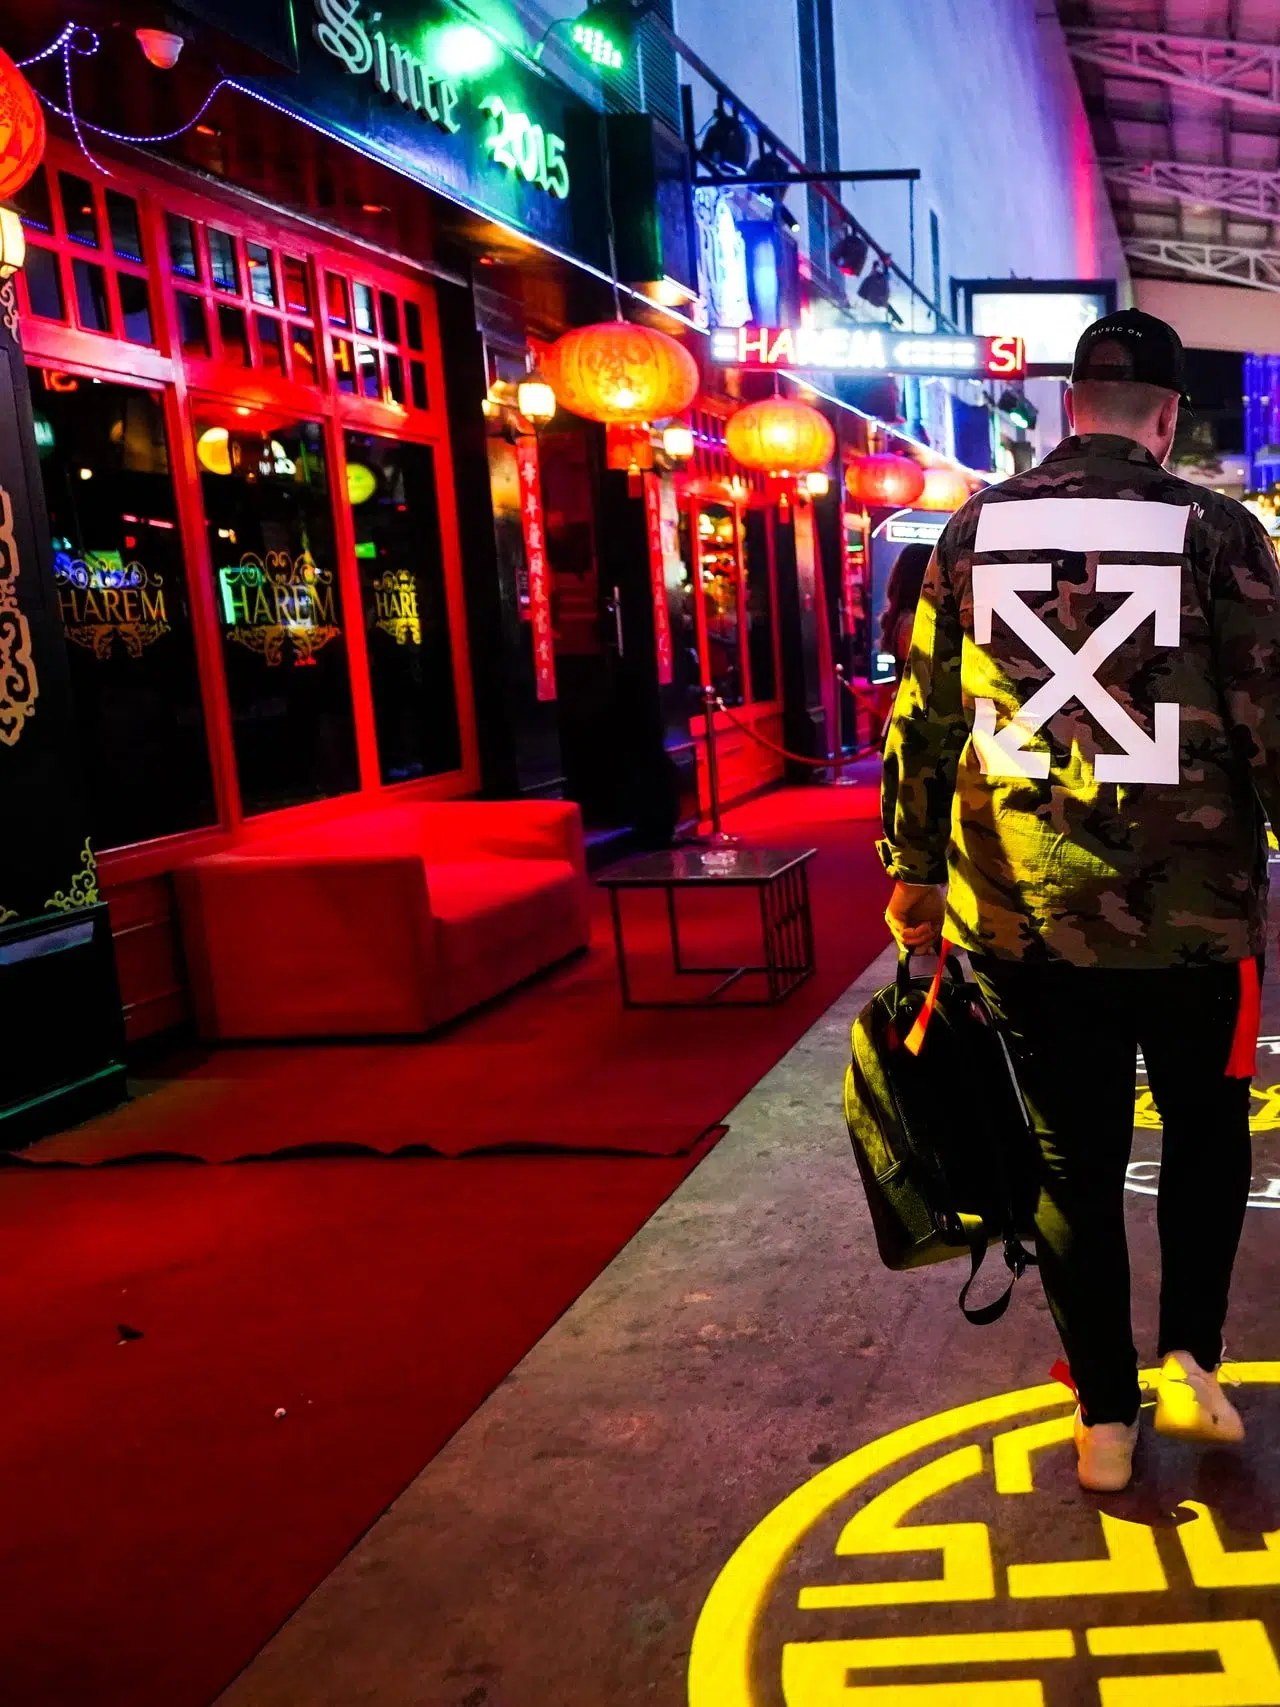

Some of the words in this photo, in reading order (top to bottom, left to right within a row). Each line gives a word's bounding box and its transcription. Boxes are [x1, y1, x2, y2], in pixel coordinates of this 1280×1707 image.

[313, 0, 460, 134] Since
[478, 95, 570, 199] 2015
[738, 327, 886, 368] HAREM
[1091, 326, 1123, 336] MUSIC
[1127, 328, 1142, 337] ON
[1192, 501, 1205, 519] TM
[57, 589, 168, 623] HAREM
[221, 584, 338, 625] HAREM
